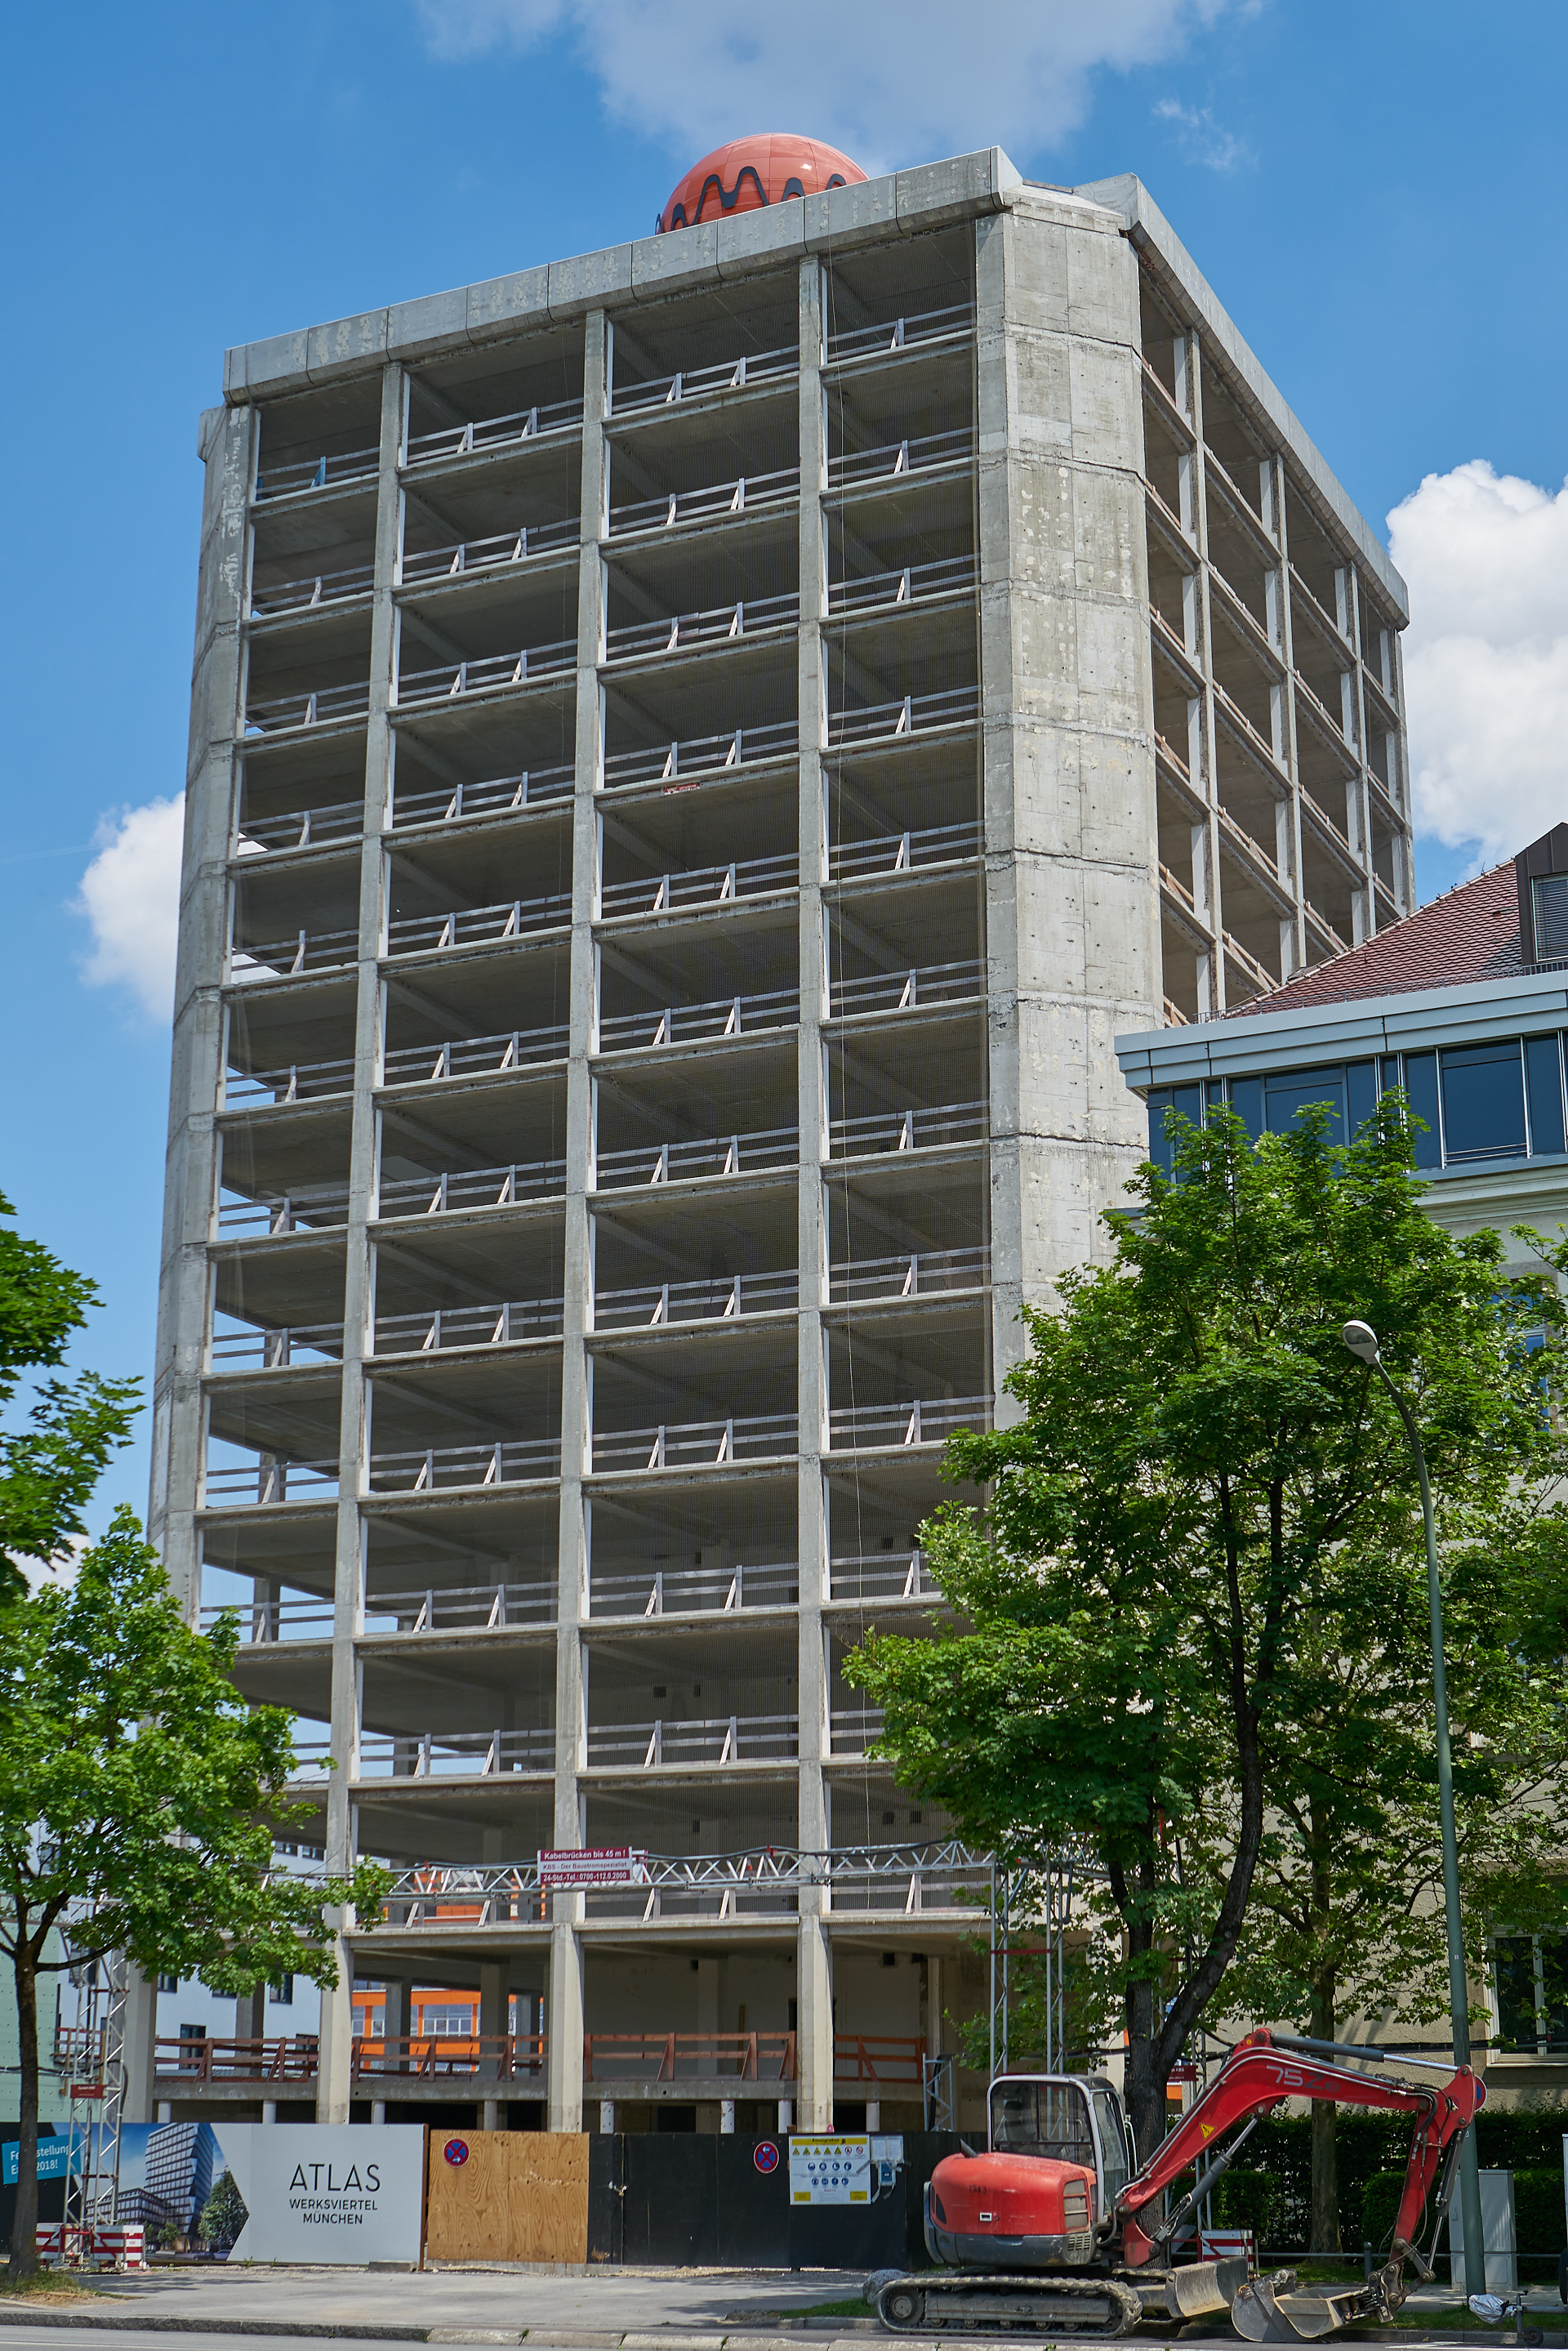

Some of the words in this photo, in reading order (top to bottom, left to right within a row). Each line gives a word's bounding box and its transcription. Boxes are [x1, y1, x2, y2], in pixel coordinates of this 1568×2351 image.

[545, 1851, 591, 1860] Kabelbrücken
[593, 1850, 604, 1858] bis
[604, 1850, 614, 1858] 45
[572, 1861, 627, 1870] Baustromspezialist
[36, 2158, 59, 2172] 2018!
[289, 2163, 381, 2193] ATLAS
[289, 2198, 378, 2210] WERKSVIERTEL
[303, 2210, 363, 2224] MÜNCHEN
